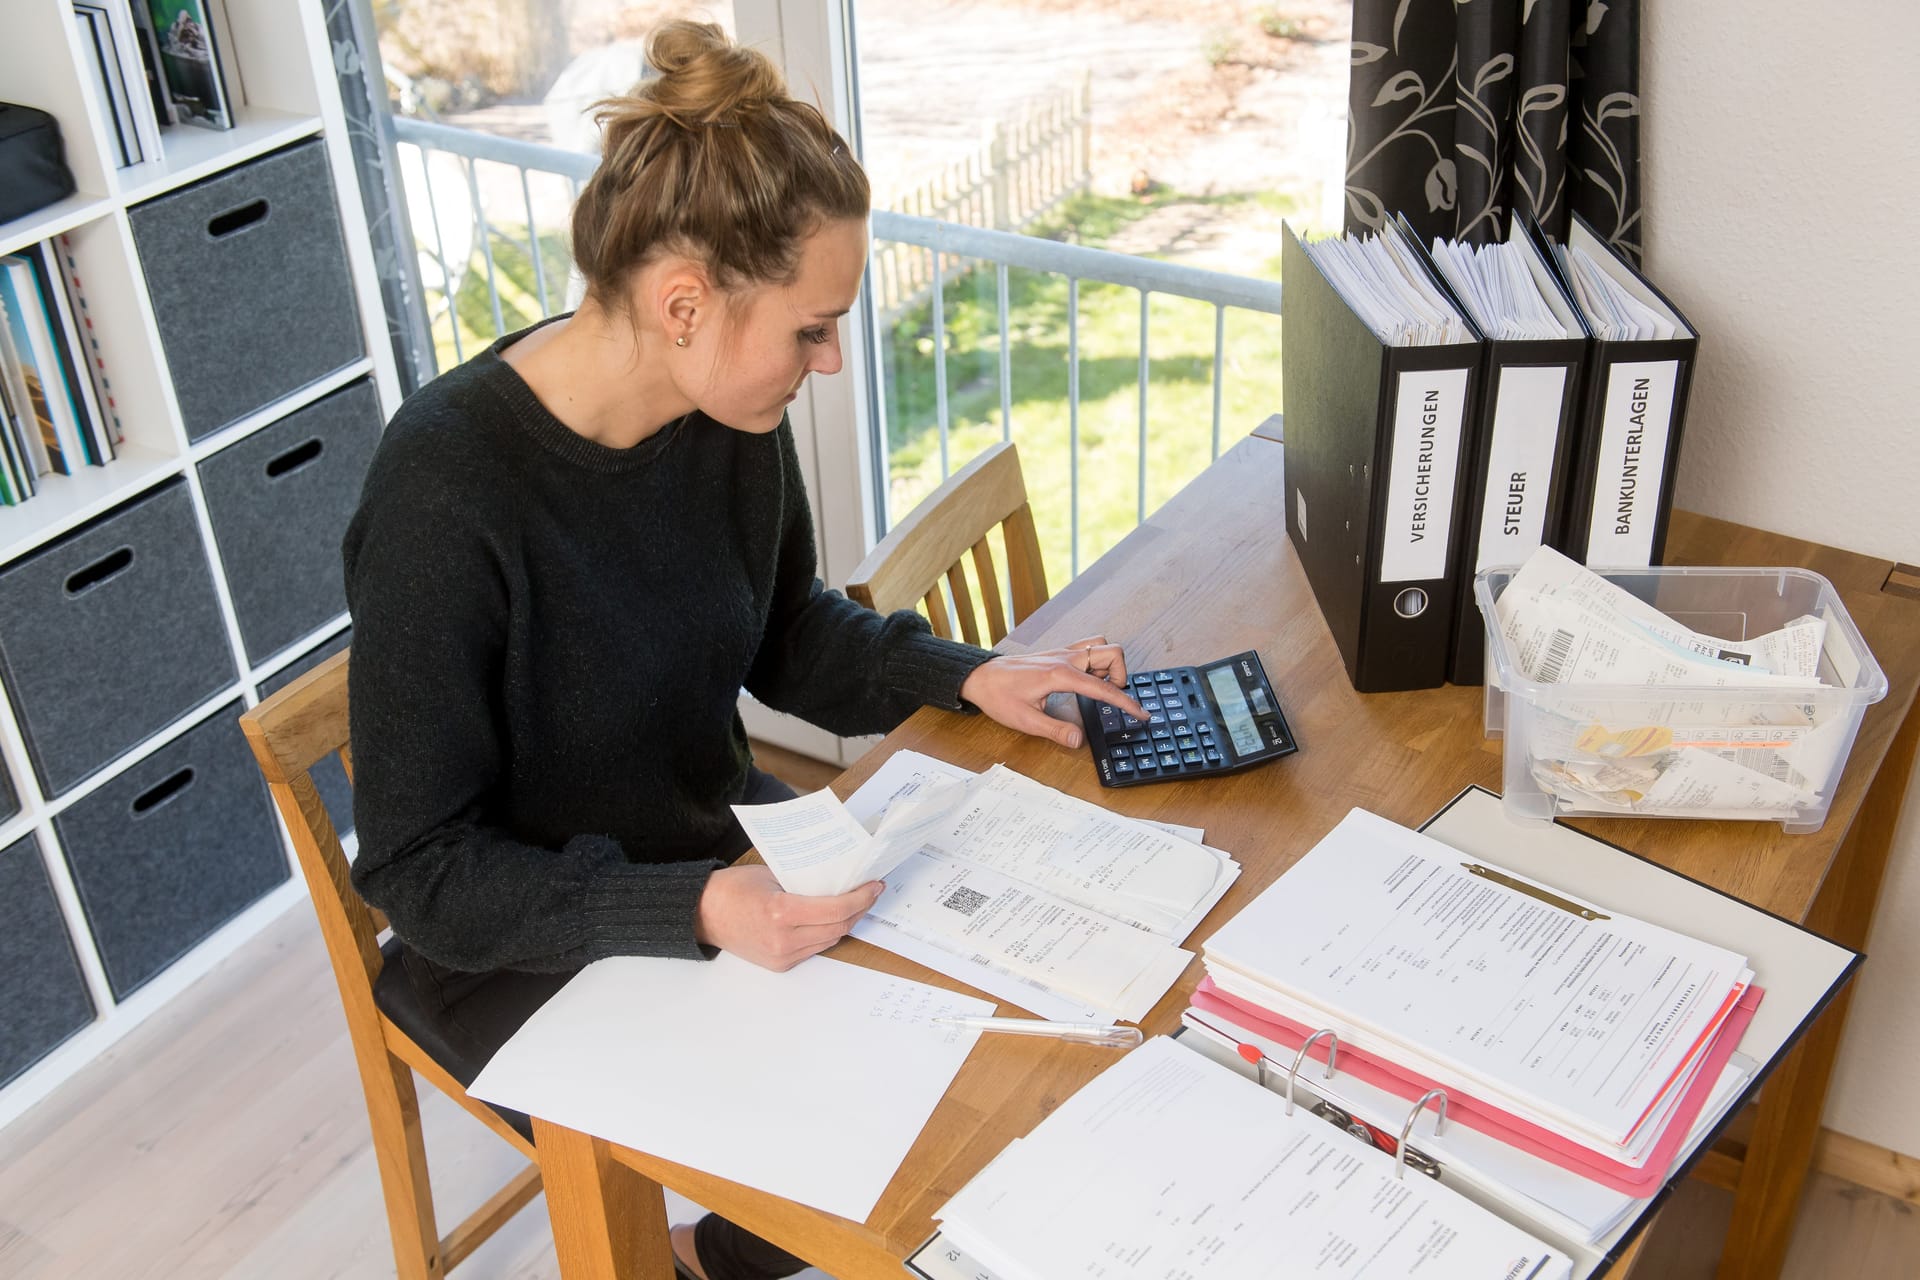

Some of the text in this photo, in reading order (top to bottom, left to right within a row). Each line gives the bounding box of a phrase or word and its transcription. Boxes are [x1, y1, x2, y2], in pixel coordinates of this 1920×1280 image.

[1411, 390, 1439, 543] VERSICHERUNGEN
[1615, 378, 1650, 535] BANKUNTERLAGEN
[1503, 471, 1527, 536] STEUER
[1241, 660, 1252, 677] CASIO
[945, 1249, 961, 1262] 12
[1504, 1256, 1529, 1280] amazo
